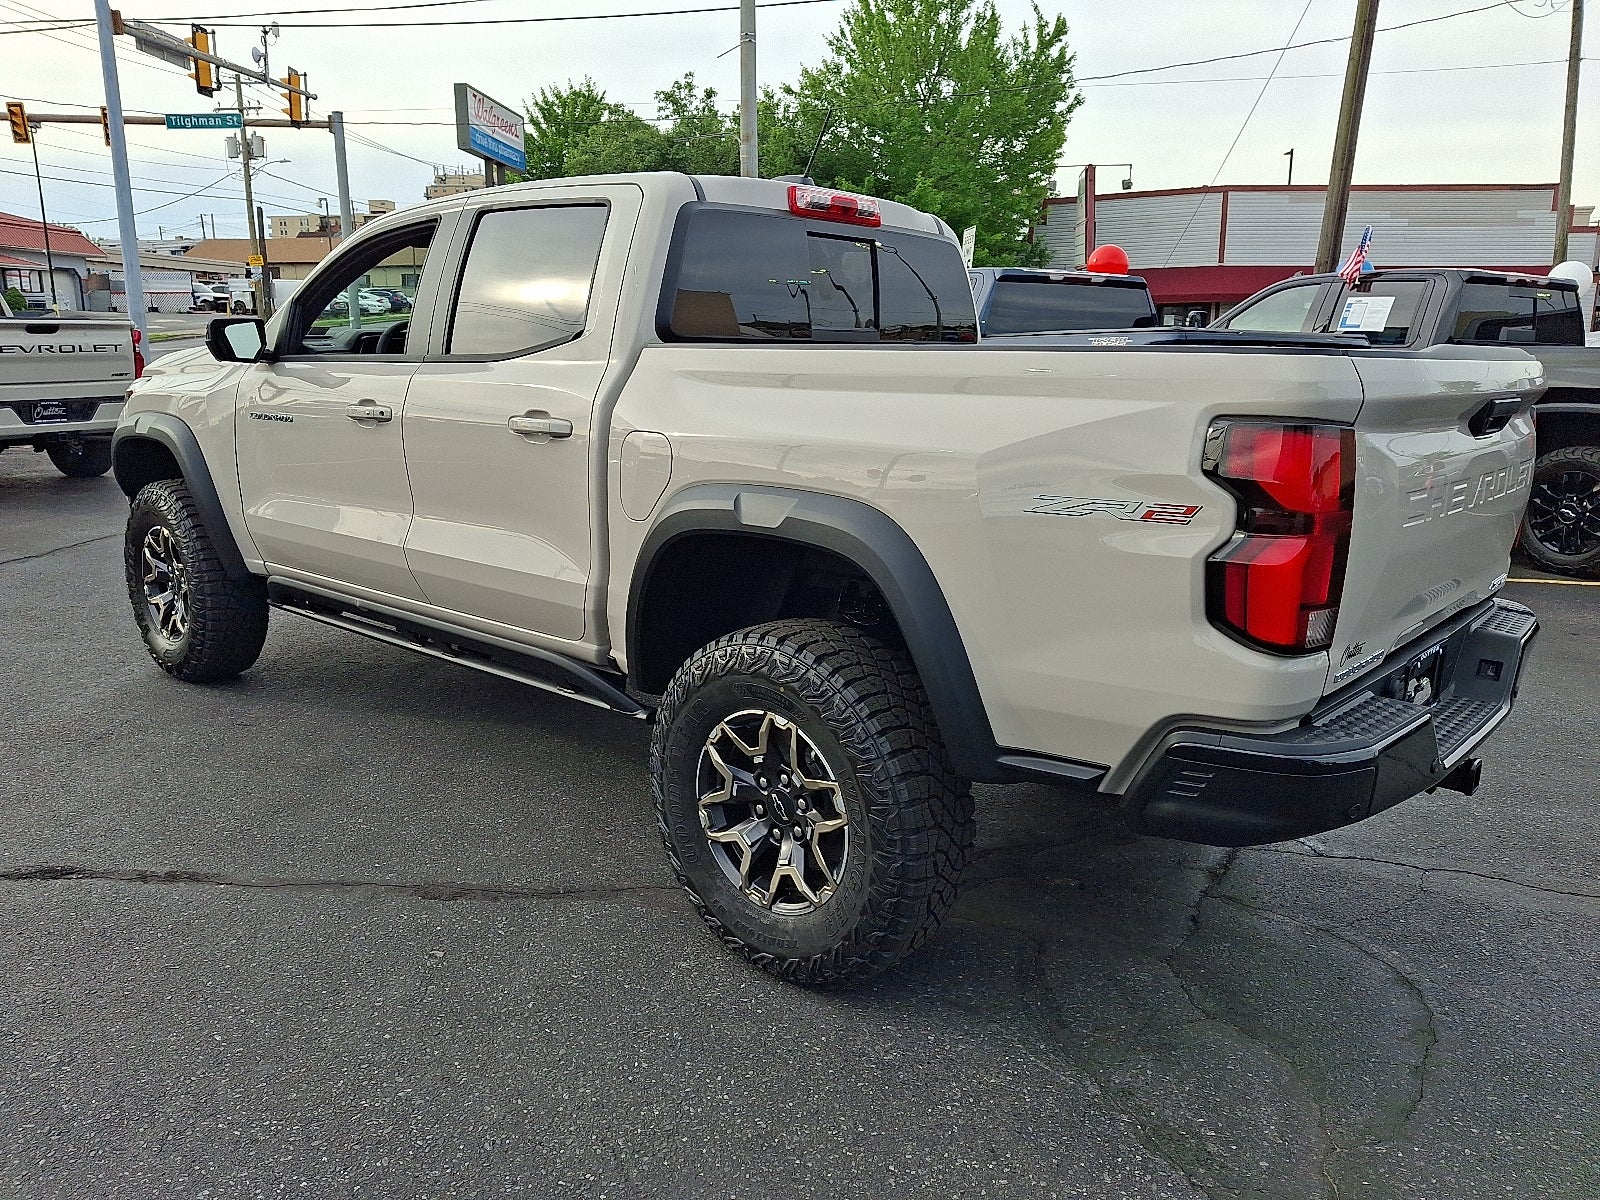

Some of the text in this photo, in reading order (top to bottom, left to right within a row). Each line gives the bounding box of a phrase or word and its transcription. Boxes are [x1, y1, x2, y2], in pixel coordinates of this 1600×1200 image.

[170, 115, 238, 128] Tilghman St
[472, 93, 520, 138] Walgreens
[1022, 494, 1204, 526] ZR2
